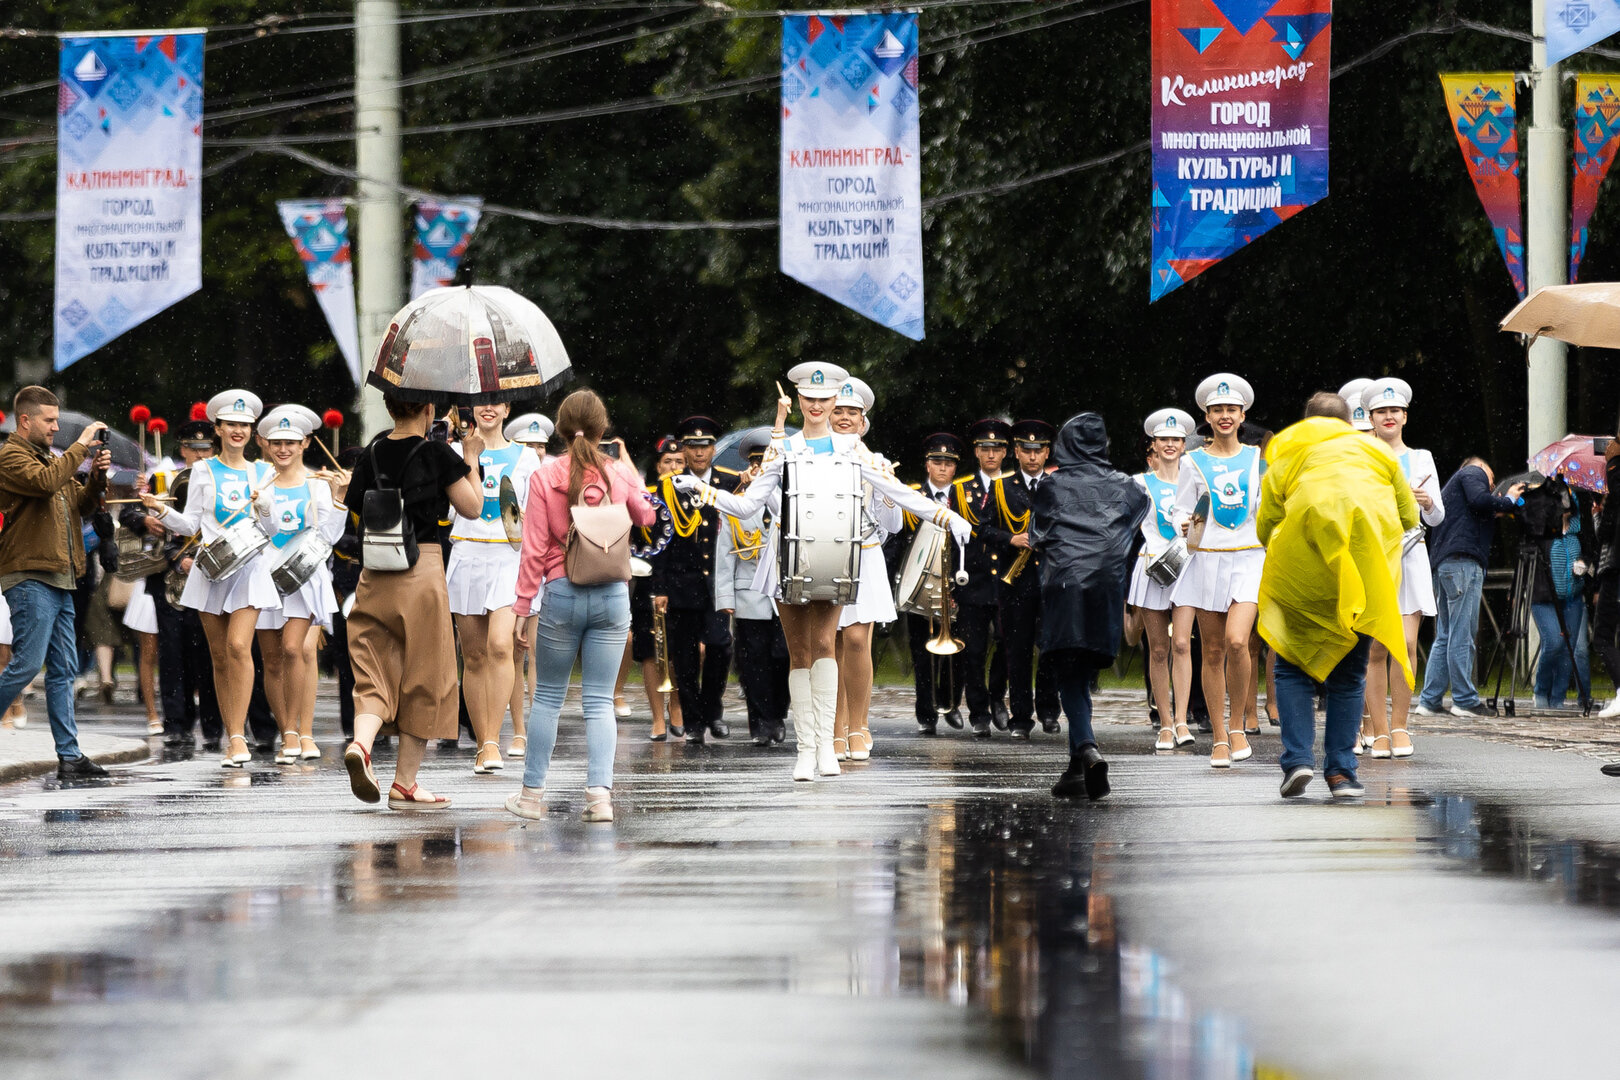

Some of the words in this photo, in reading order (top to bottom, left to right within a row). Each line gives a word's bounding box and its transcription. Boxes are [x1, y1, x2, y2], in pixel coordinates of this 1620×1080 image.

[1161, 61, 1314, 107] Калининград-
[1211, 102, 1270, 127] ГОРОД
[1161, 124, 1311, 151] МНОГОНАЦИОНАЛЬНОЙ
[790, 146, 912, 168] КАЛИНИНГРАД-
[1178, 155, 1277, 179] КУЛЬТУРЫ
[1281, 154, 1292, 176] И
[828, 177, 876, 195] ГОРОД
[1189, 181, 1282, 214] ТРАДИЦИЙ
[102, 198, 155, 216] ГОРОД
[798, 196, 904, 213] МНОГОНАЦИОНАЛЬНОЙ
[808, 218, 882, 237] КУЛЬТУРЫ
[886, 217, 895, 234] И
[84, 240, 162, 259] КУЛЬТУРЫ
[814, 238, 890, 261] ТРАДИЦИЙ
[90, 259, 169, 283] ТРАДИЦИЙ
